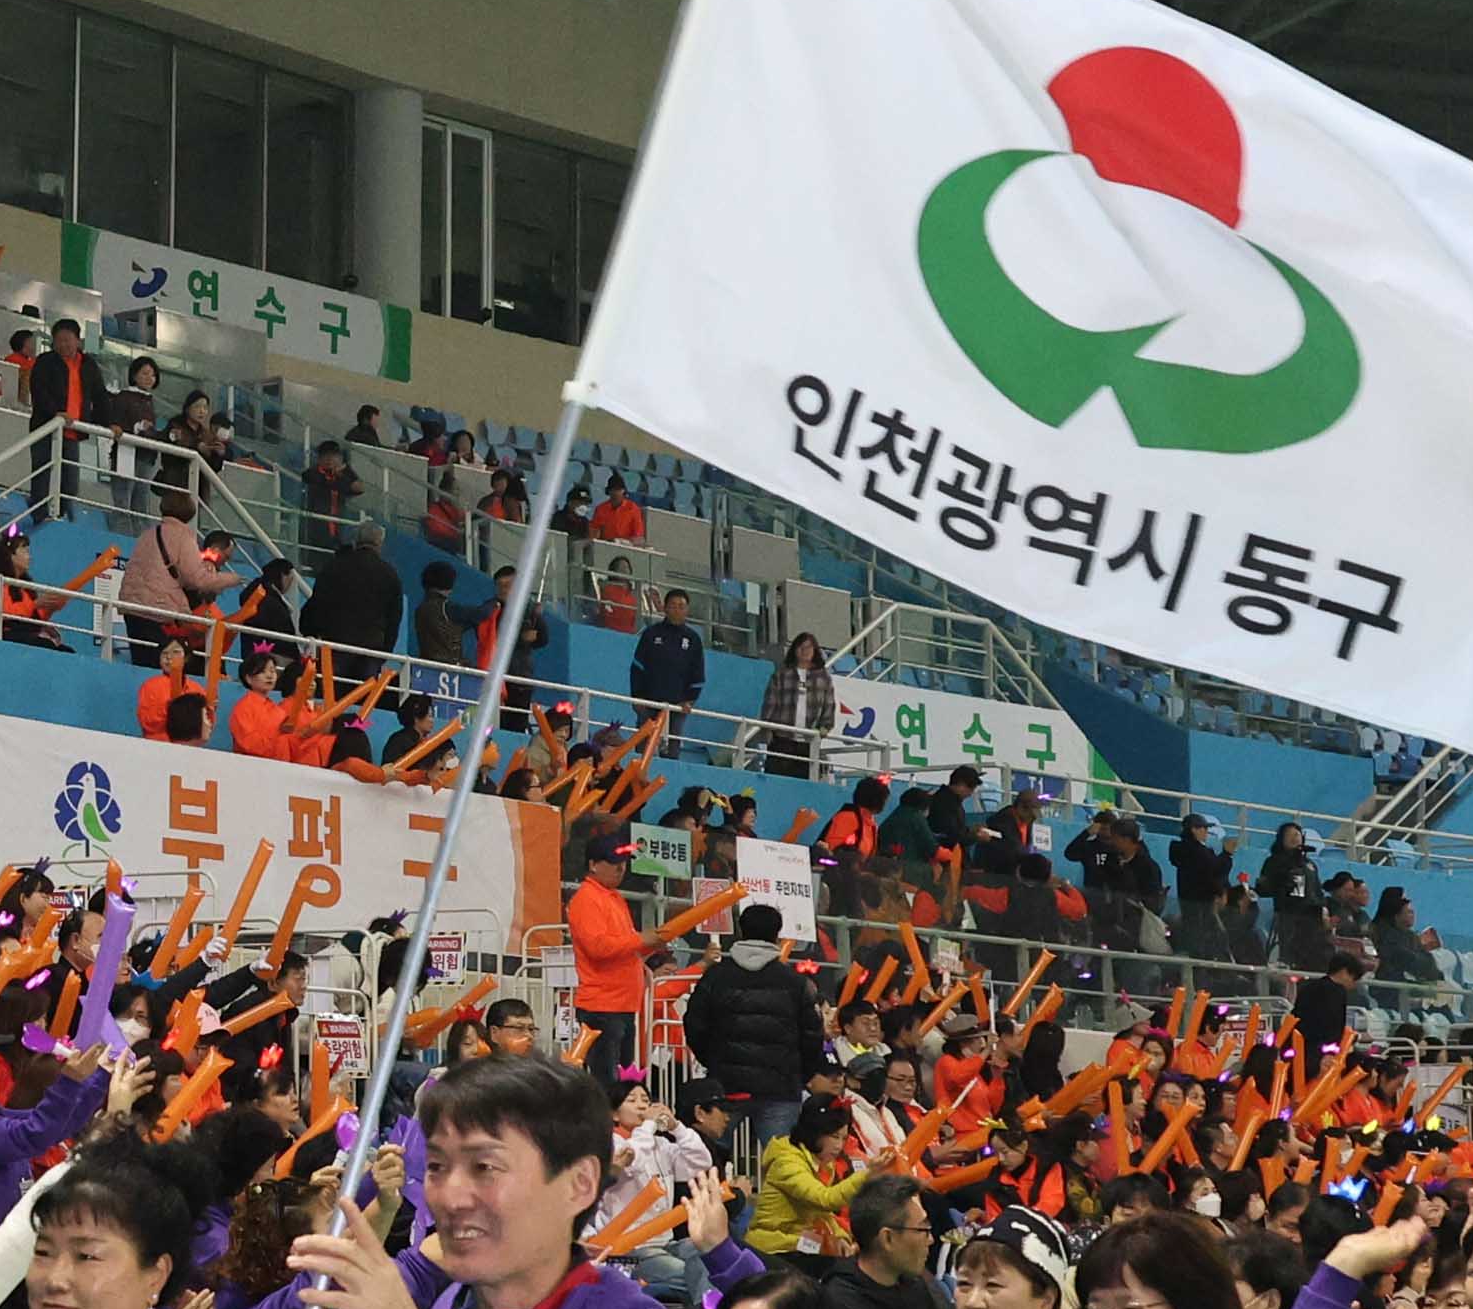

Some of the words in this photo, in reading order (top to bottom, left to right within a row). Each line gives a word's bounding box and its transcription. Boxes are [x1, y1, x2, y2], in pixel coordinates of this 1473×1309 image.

[188, 270, 350, 353] 연수구
[787, 375, 1202, 612] 인천광역시
[1224, 534, 1403, 660] 동구
[438, 672, 460, 700] S1
[896, 703, 1057, 770] 연수구
[162, 775, 458, 909] 부평구
[650, 837, 687, 863] 부평2동
[429, 939, 459, 949] ARNING
[433, 953, 458, 971] 위험
